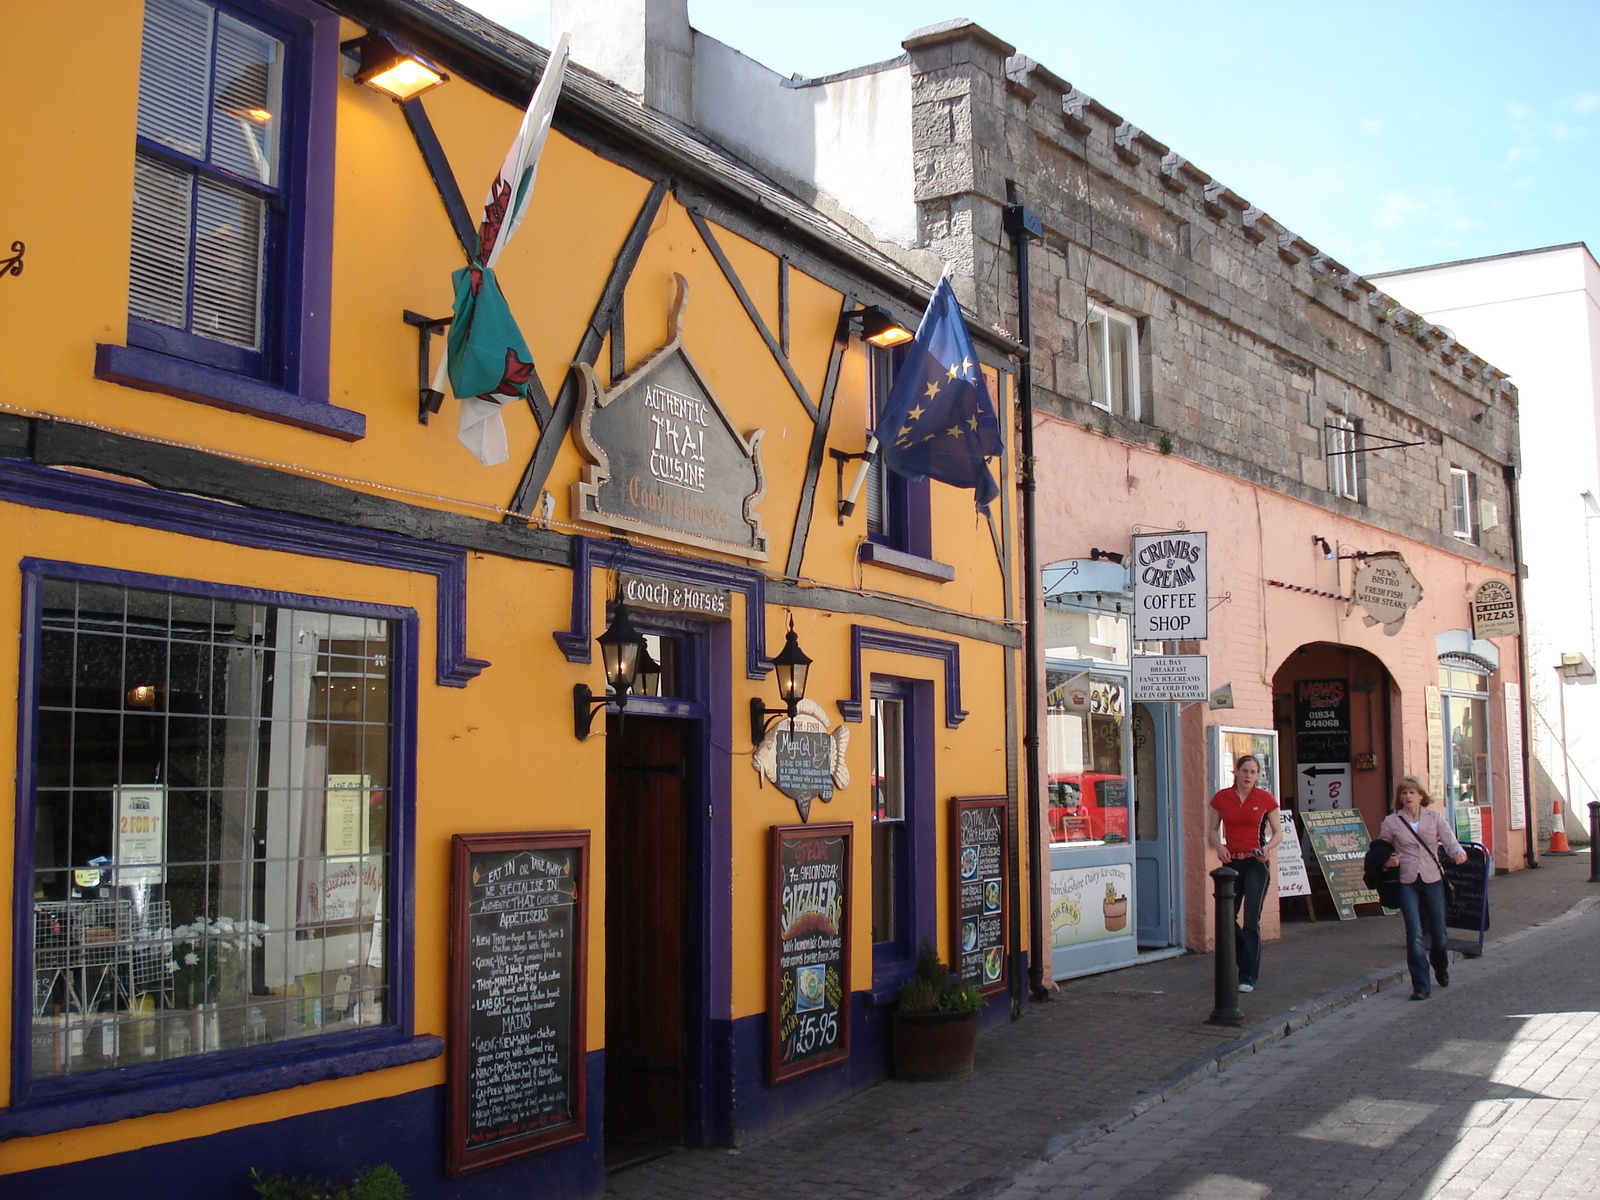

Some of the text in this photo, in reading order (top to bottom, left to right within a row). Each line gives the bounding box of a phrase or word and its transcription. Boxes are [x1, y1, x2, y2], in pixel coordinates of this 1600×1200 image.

[644, 386, 708, 428] AUTHENTIC
[651, 414, 705, 464] THAI
[650, 449, 705, 490] CUISINE
[628, 475, 669, 517] Coach
[682, 490, 728, 530] Horses
[1138, 540, 1201, 567] CRUMBS
[1166, 558, 1175, 569] &
[1142, 564, 1196, 588] CREAM
[1371, 576, 1400, 587] BISTRO
[1375, 568, 1397, 578] MEWS
[627, 579, 724, 613] Coach & Horses
[1143, 593, 1196, 610] COFFEE
[1358, 593, 1408, 610] WELSH STEAKS
[1364, 586, 1403, 600] FRESH FISH
[1149, 615, 1191, 632] SHOP
[1476, 610, 1515, 622] PIZZAS
[1305, 719, 1340, 728] 844068
[1308, 710, 1335, 720] 01834
[787, 720, 803, 731] FESH
[800, 735, 811, 756] Cod
[121, 816, 128, 833] 2
[130, 816, 149, 833] FOR
[1280, 814, 1292, 824] EN
[795, 841, 829, 865] SPECIAL
[1324, 853, 1347, 861] TENBY
[488, 856, 561, 883] EAT IN OR TAKE AWAY
[821, 863, 838, 880] STEAK
[1085, 870, 1100, 885] Dairy
[1100, 867, 1126, 880] Ice-cream
[486, 879, 557, 896] WE SPECIALISE IN
[511, 895, 535, 909] THAI
[781, 880, 838, 934] SIZZLER
[510, 964, 522, 974] black
[524, 963, 540, 975] pepper
[502, 1012, 531, 1035] MAINS
[477, 1055, 494, 1067] green
[512, 1049, 523, 1057] with
[524, 1041, 543, 1055] steamed
[544, 1043, 555, 1052] rice
